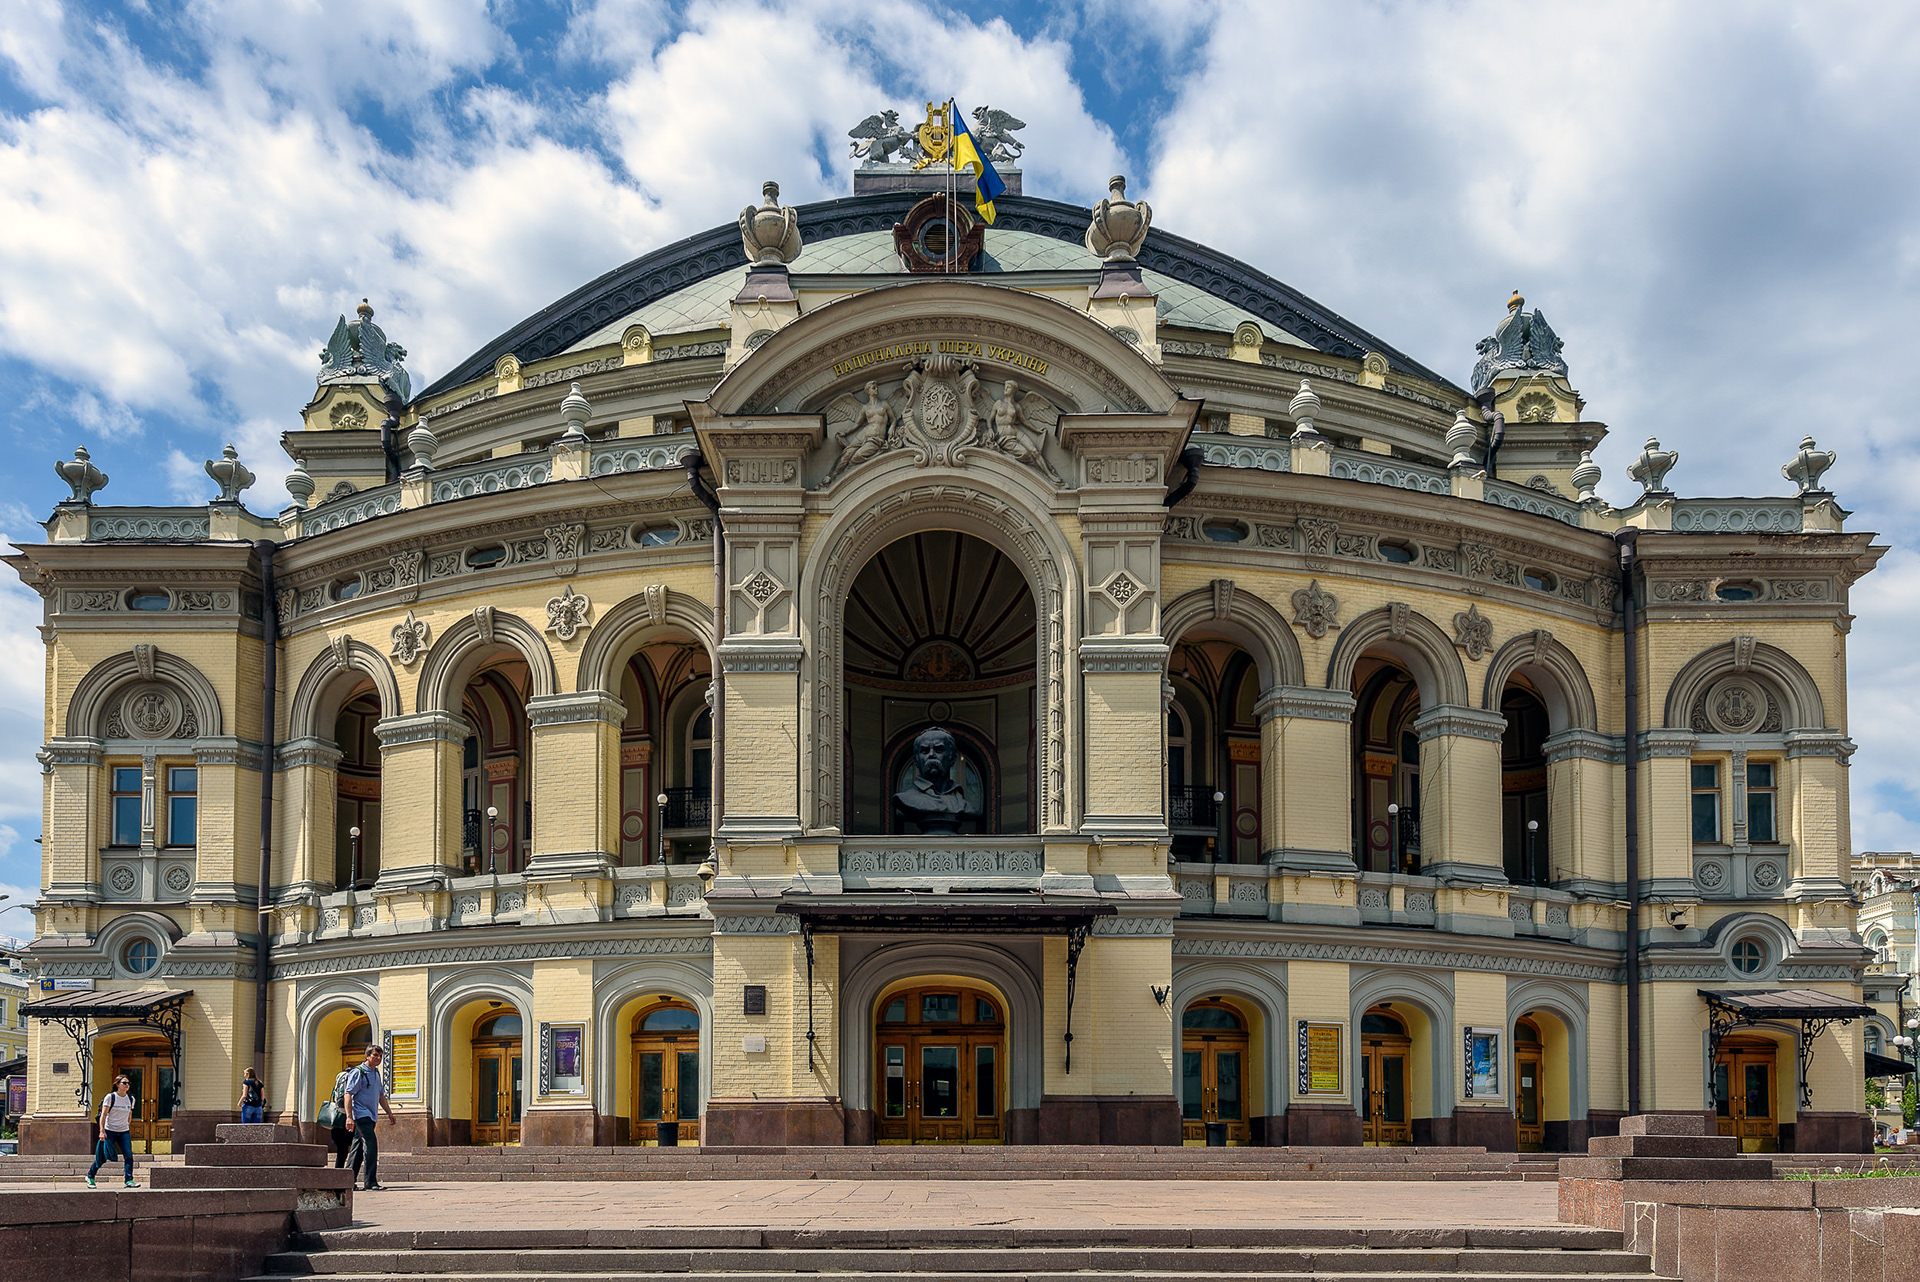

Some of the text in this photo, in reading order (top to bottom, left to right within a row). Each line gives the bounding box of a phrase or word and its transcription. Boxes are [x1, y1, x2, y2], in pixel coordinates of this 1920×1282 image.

[833, 341, 932, 377] НАЦІОНАЛЬНА
[938, 341, 982, 356] ОПЕРА
[1101, 460, 1144, 483] 1901
